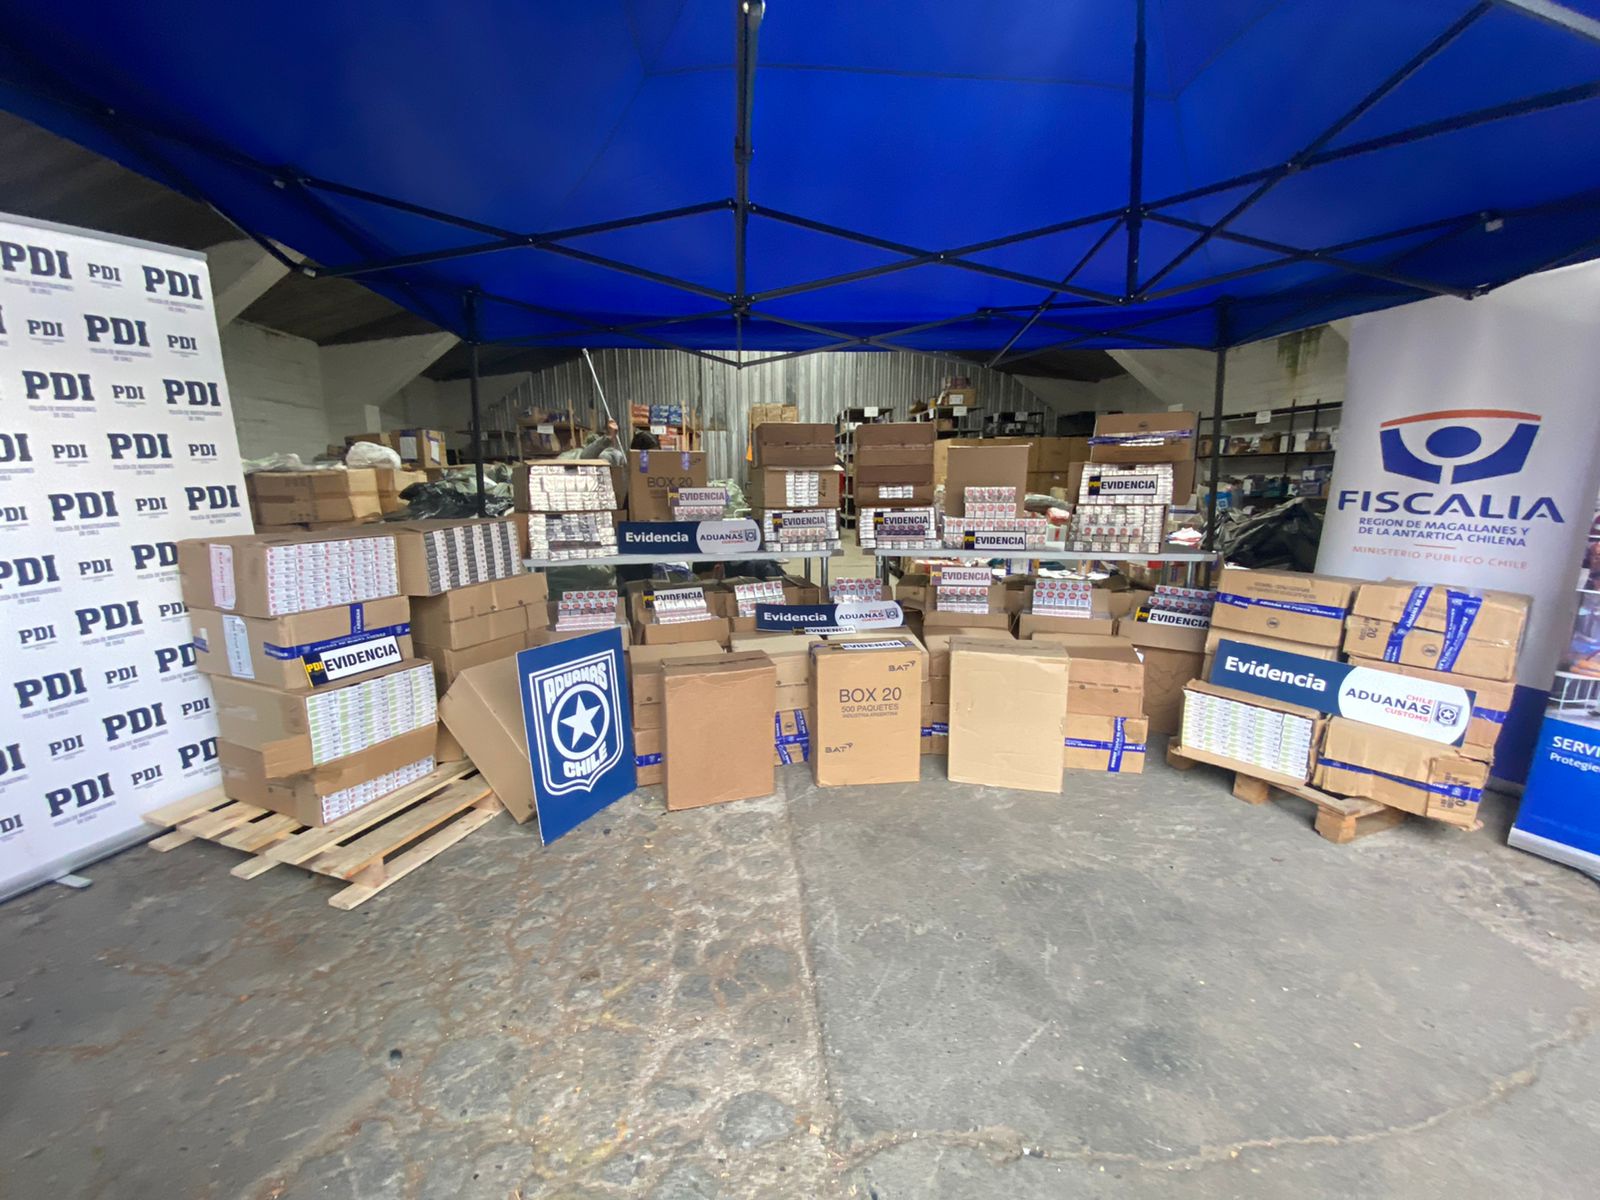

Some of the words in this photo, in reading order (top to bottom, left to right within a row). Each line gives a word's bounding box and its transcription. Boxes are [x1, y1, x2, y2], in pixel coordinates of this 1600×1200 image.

[0, 241, 71, 279] PDI
[88, 264, 121, 281] PDI
[143, 266, 202, 300] PDI
[28, 320, 63, 336] PDI
[84, 315, 149, 347] PDI
[168, 335, 197, 350] PDI
[22, 371, 94, 401] PDI
[112, 385, 144, 399] PDI
[163, 379, 221, 406] PDI
[0, 433, 32, 462] DI
[53, 444, 87, 459] PDI
[107, 433, 172, 459] PDI
[188, 443, 216, 457] PDI
[647, 476, 675, 488] BOX
[1101, 480, 1155, 490] EVIDENCIA
[136, 497, 167, 511] PDI
[185, 485, 239, 510] PDI
[680, 491, 725, 501] EVIDENCIA
[48, 491, 118, 521] PDI
[1338, 490, 1565, 523] FISCALIA
[783, 516, 826, 526] EVIDENCIA
[884, 515, 928, 525] EVIDENCIA
[1359, 517, 1403, 528] REGION
[1406, 519, 1421, 529] DE
[1424, 521, 1516, 535] MAGALLANES
[1521, 527, 1529, 536] Y
[625, 531, 689, 543] Evidencia
[700, 533, 743, 541] ADUANAS
[975, 535, 1024, 545] EVIDENCIA
[1358, 526, 1373, 535] DE
[1376, 528, 1390, 537] LA
[1392, 529, 1463, 541] ANTARTICA
[1467, 534, 1526, 547] CHILENA
[132, 542, 178, 569] PD
[1352, 546, 1421, 560] MINISTERIO
[1425, 552, 1484, 566] PUBLICO
[1488, 558, 1528, 570] CHILE
[79, 559, 113, 575] PDI
[942, 571, 990, 581] EVIDENCIA
[75, 601, 142, 635] PDI
[763, 612, 827, 622] Evidencia
[838, 612, 884, 620] ADUANAS
[1150, 612, 1210, 629] EVIDENCIA
[19, 625, 55, 643] PDI
[155, 643, 196, 673] PD
[324, 643, 398, 673] EVIDENCIA
[105, 666, 137, 683] PDI
[1224, 655, 1327, 692] Evidencia
[14, 668, 87, 708] PDI
[543, 661, 608, 714] ADUANAS
[839, 687, 877, 703] BOX
[882, 686, 902, 701] 20
[182, 698, 210, 715] PDI
[841, 705, 855, 713] 500
[856, 703, 899, 712] PAQUETES
[1345, 688, 1431, 716] ADUANAS
[1406, 694, 1433, 705] CHILE
[102, 702, 167, 741] PDI
[1384, 706, 1429, 723] CUSTOMS
[49, 735, 84, 756] PDI
[178, 737, 218, 769] PD
[563, 741, 608, 778] CHILE
[1550, 752, 1600, 773] Protegie
[132, 765, 162, 785] PDI
[45, 773, 115, 817] PDI
[0, 815, 22, 834] DI
